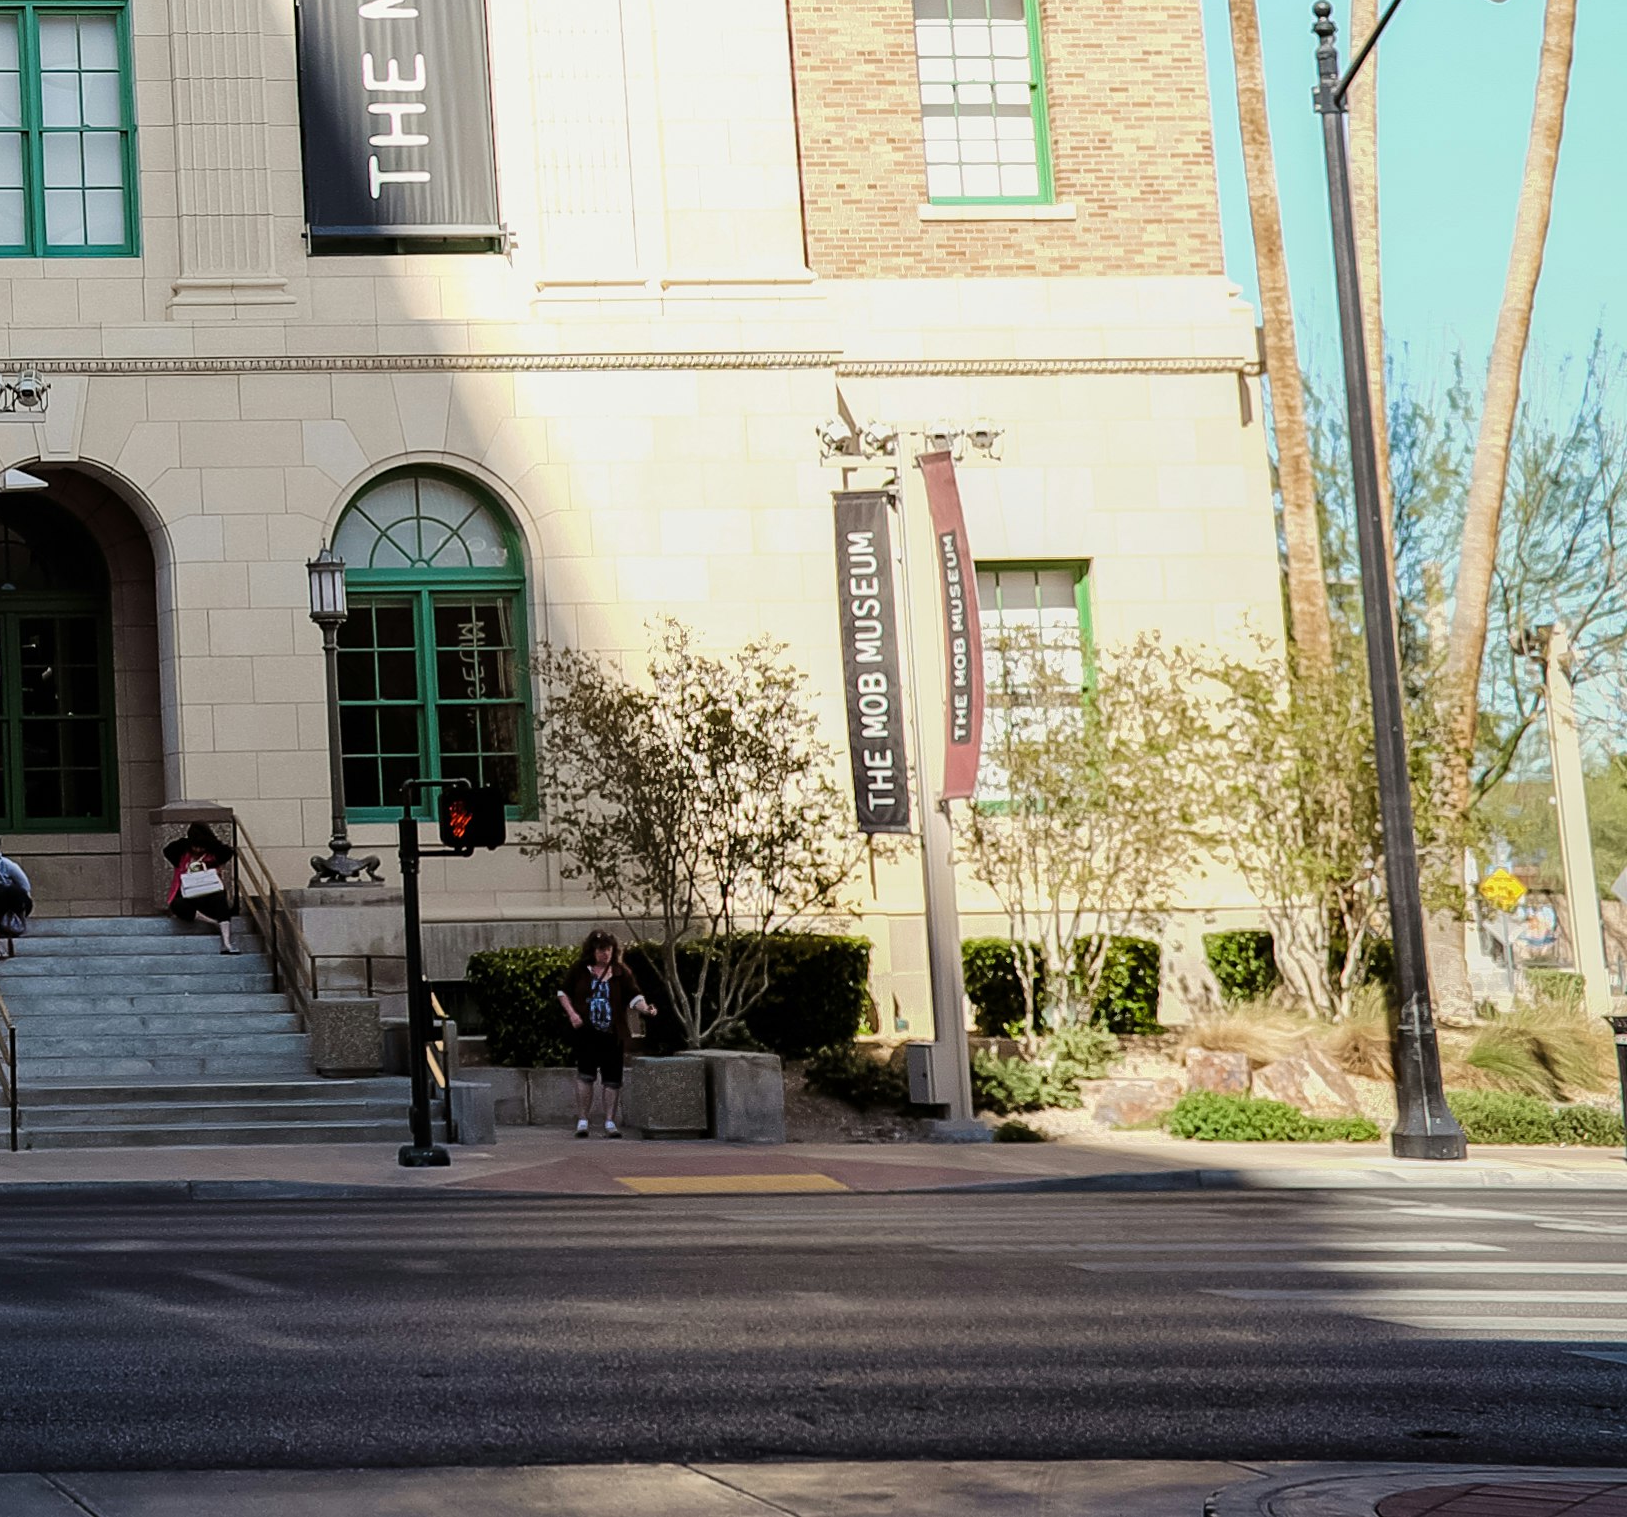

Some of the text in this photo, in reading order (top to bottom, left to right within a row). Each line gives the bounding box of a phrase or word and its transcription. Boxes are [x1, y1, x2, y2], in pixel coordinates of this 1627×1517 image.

[362, 52, 432, 200] THE
[847, 531, 897, 812] THE MOB MUSEUM
[943, 535, 968, 741] THE MOB MUSEUM
